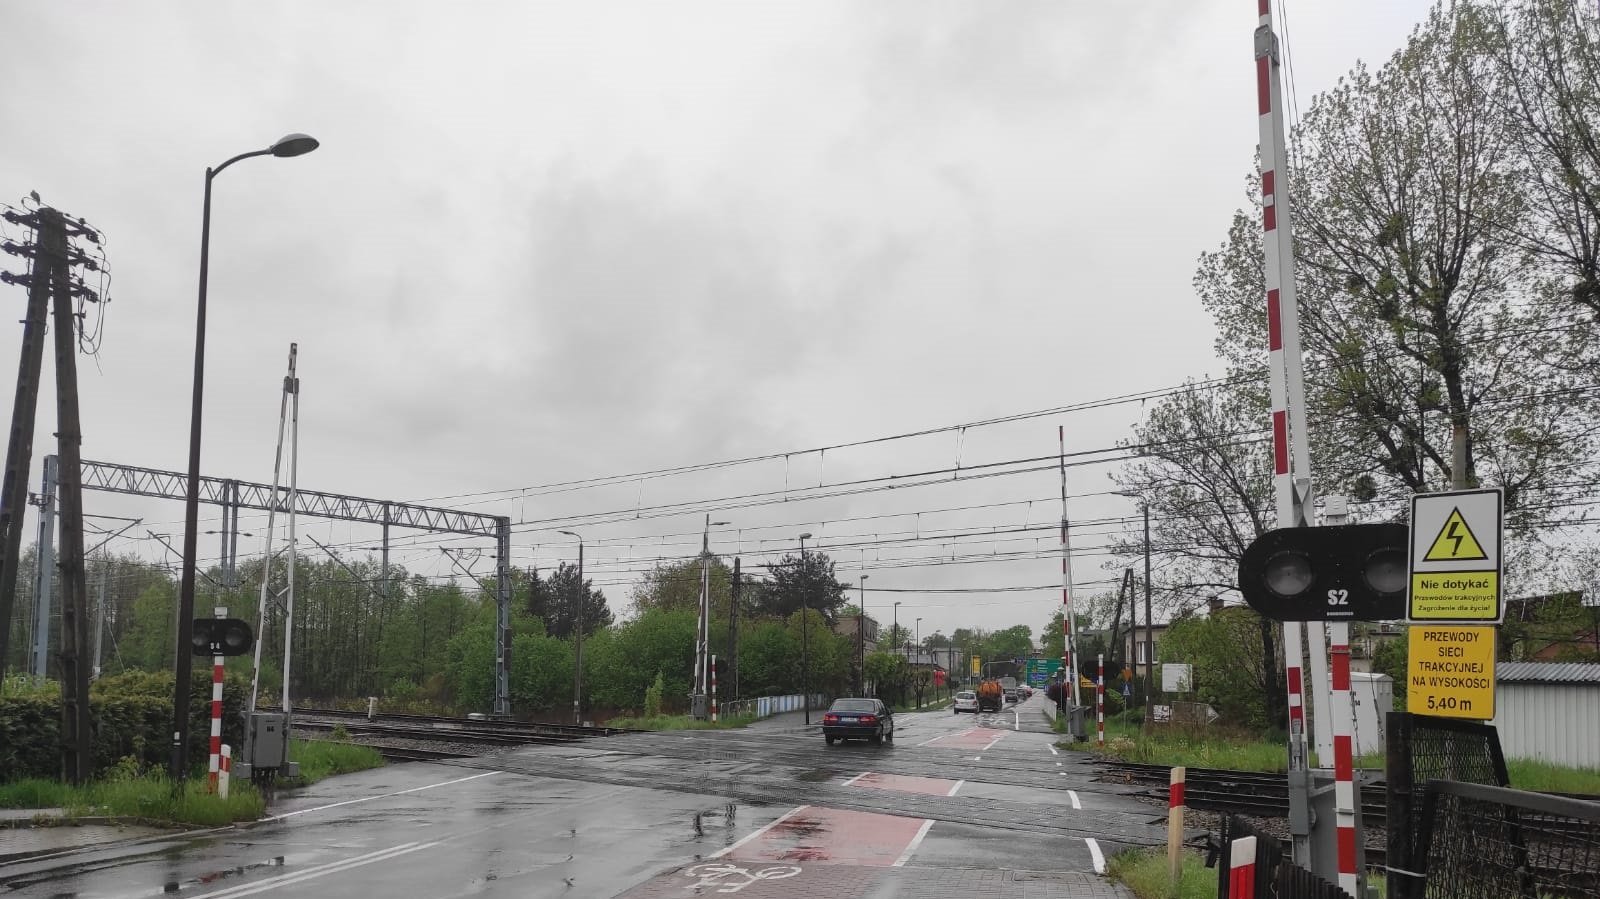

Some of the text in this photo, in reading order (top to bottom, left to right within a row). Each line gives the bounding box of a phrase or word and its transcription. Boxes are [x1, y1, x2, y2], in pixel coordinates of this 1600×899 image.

[1421, 578, 1489, 590] Nie dotykać
[1327, 589, 1349, 606] S2
[1418, 604, 1456, 612] Zagrożenie
[1423, 631, 1480, 642] PRZEWODY
[1438, 646, 1464, 657] SIECI
[1418, 661, 1484, 673] TRAKCYJNEJ
[1412, 676, 1426, 686] NA
[1427, 695, 1472, 711] 5,40 m
